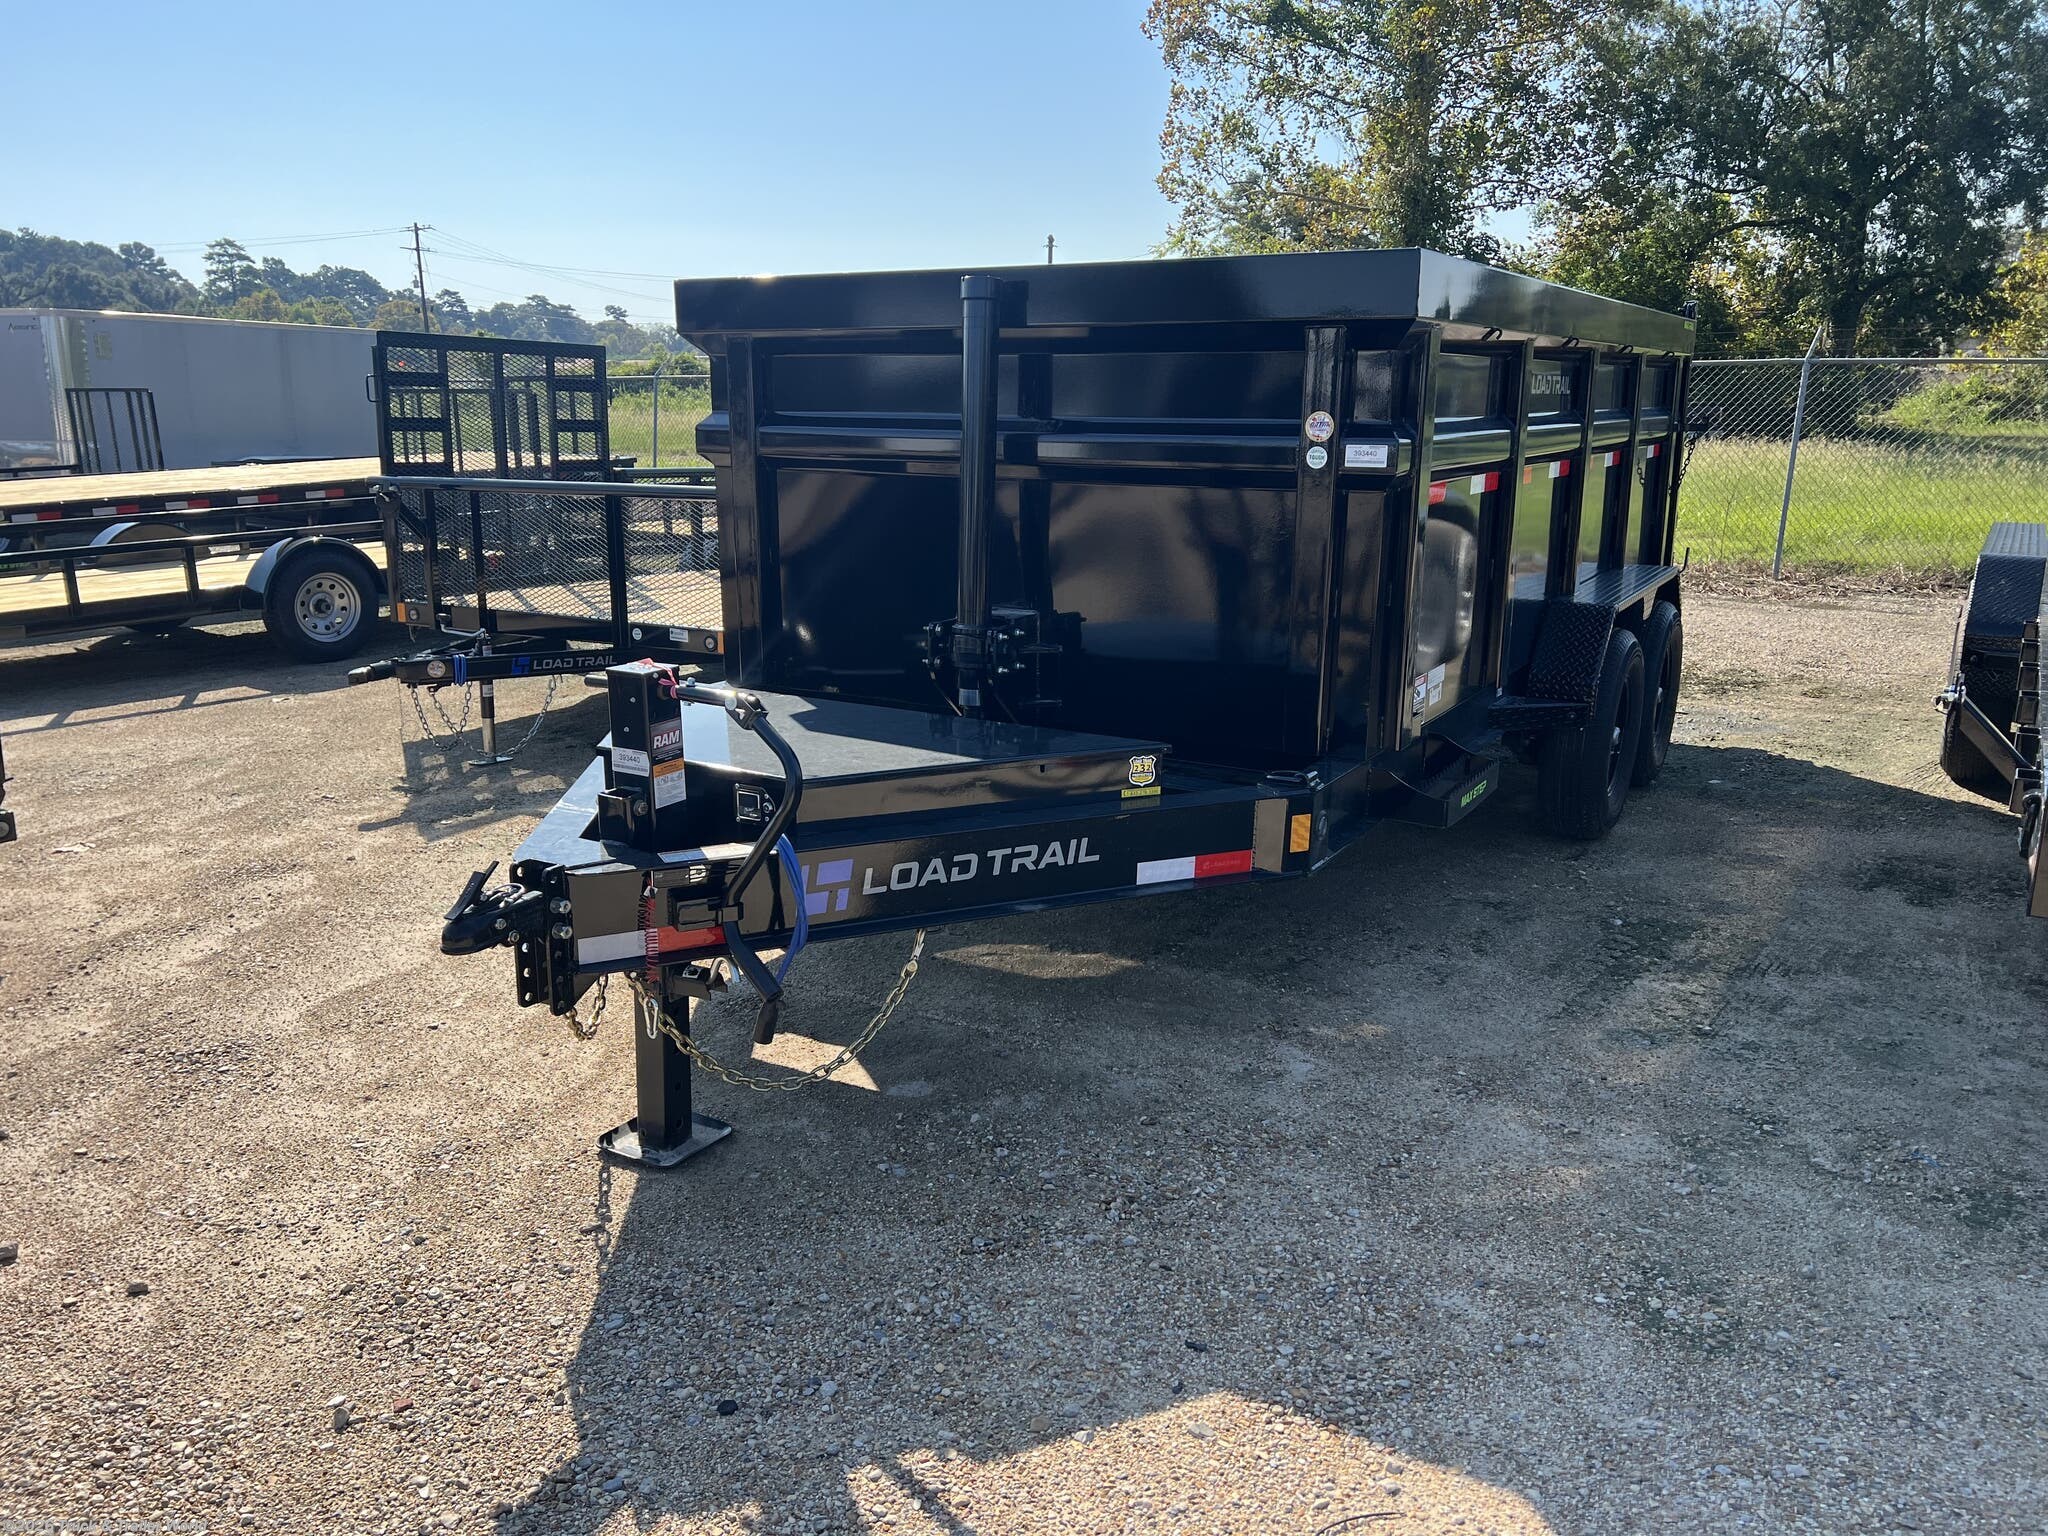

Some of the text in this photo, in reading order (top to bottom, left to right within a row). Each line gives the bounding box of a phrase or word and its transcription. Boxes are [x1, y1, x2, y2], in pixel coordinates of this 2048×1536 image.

[532, 655, 618, 670] LOAD TRAIL
[653, 730, 680, 749] RAM
[861, 837, 1100, 895] LOAD TRAIL
